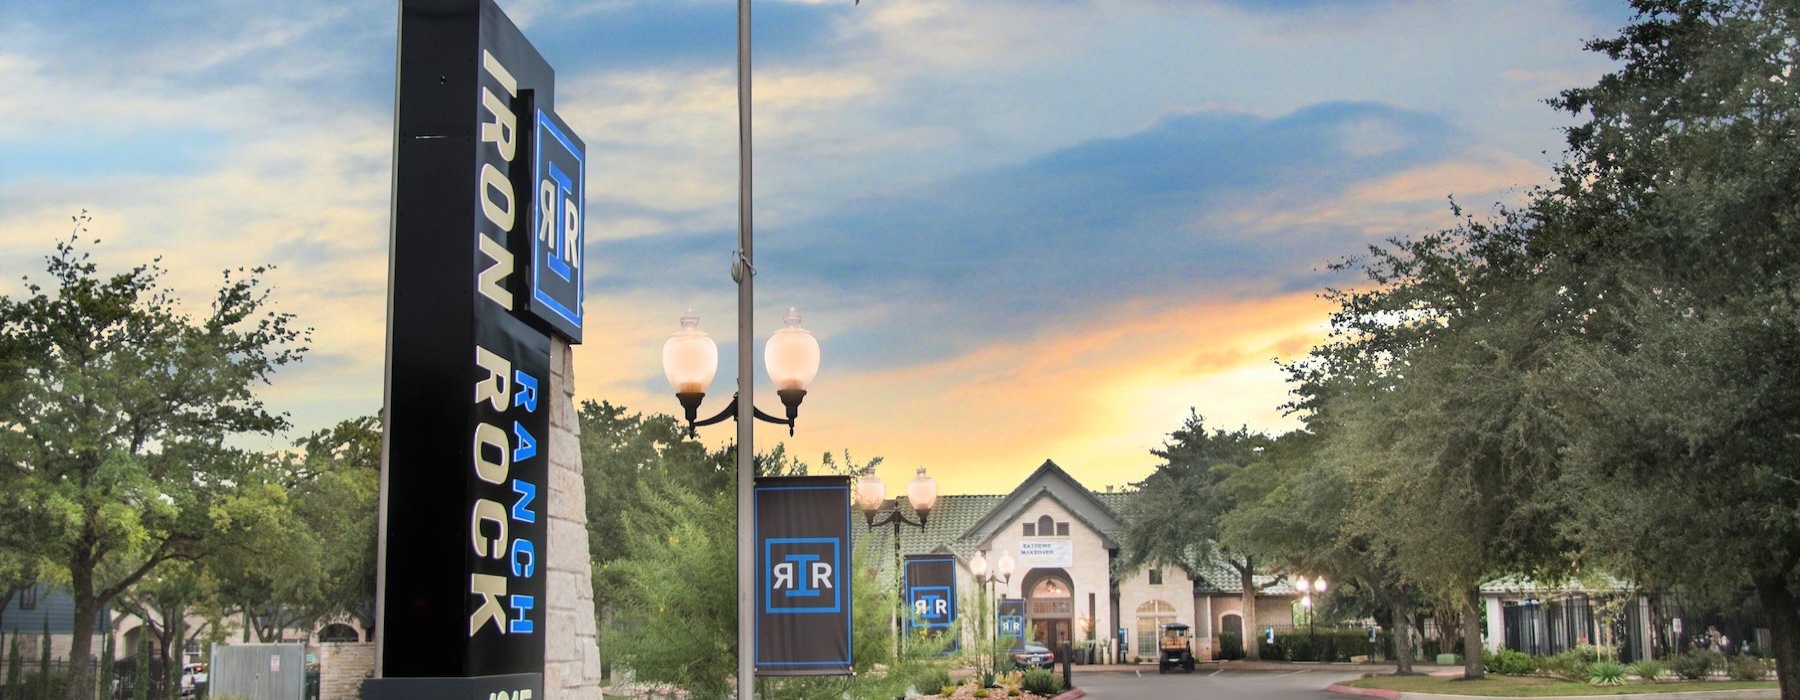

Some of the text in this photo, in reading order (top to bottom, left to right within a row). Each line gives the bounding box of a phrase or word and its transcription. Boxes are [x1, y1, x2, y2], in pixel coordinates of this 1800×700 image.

[478, 49, 517, 311] IRON
[470, 345, 511, 637] ROCK
[510, 370, 539, 634] RANCH
